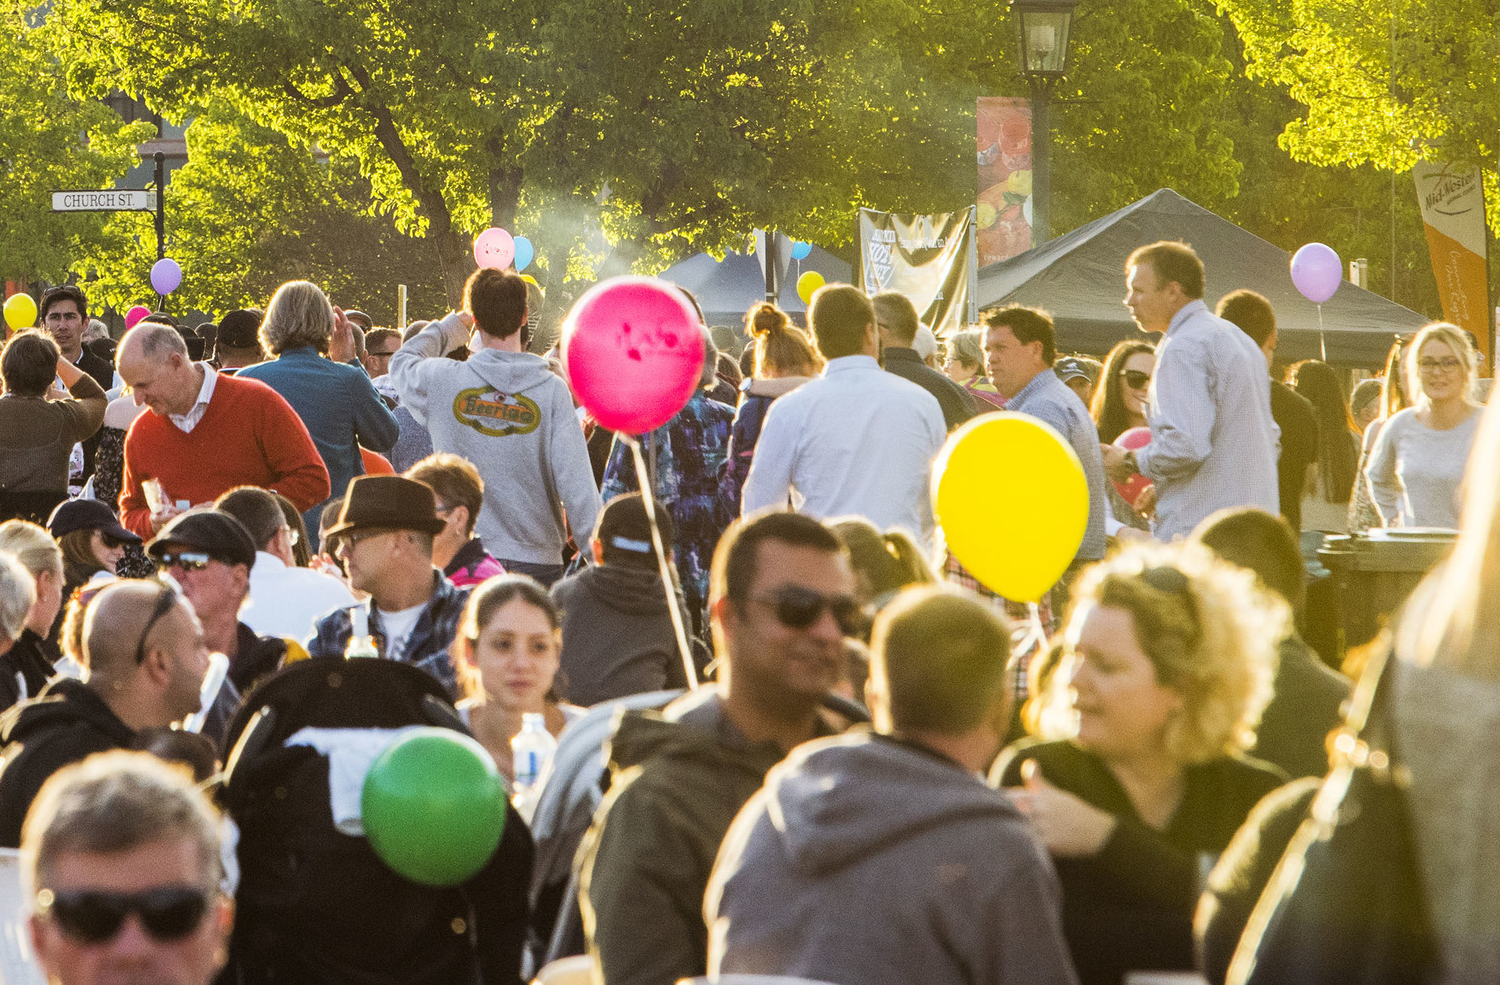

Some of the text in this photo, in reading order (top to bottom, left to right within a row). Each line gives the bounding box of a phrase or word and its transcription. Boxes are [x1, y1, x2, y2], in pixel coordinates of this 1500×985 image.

[64, 194, 115, 208] CHURCH
[118, 193, 136, 207] ST.
[466, 397, 534, 424] Beerlao
